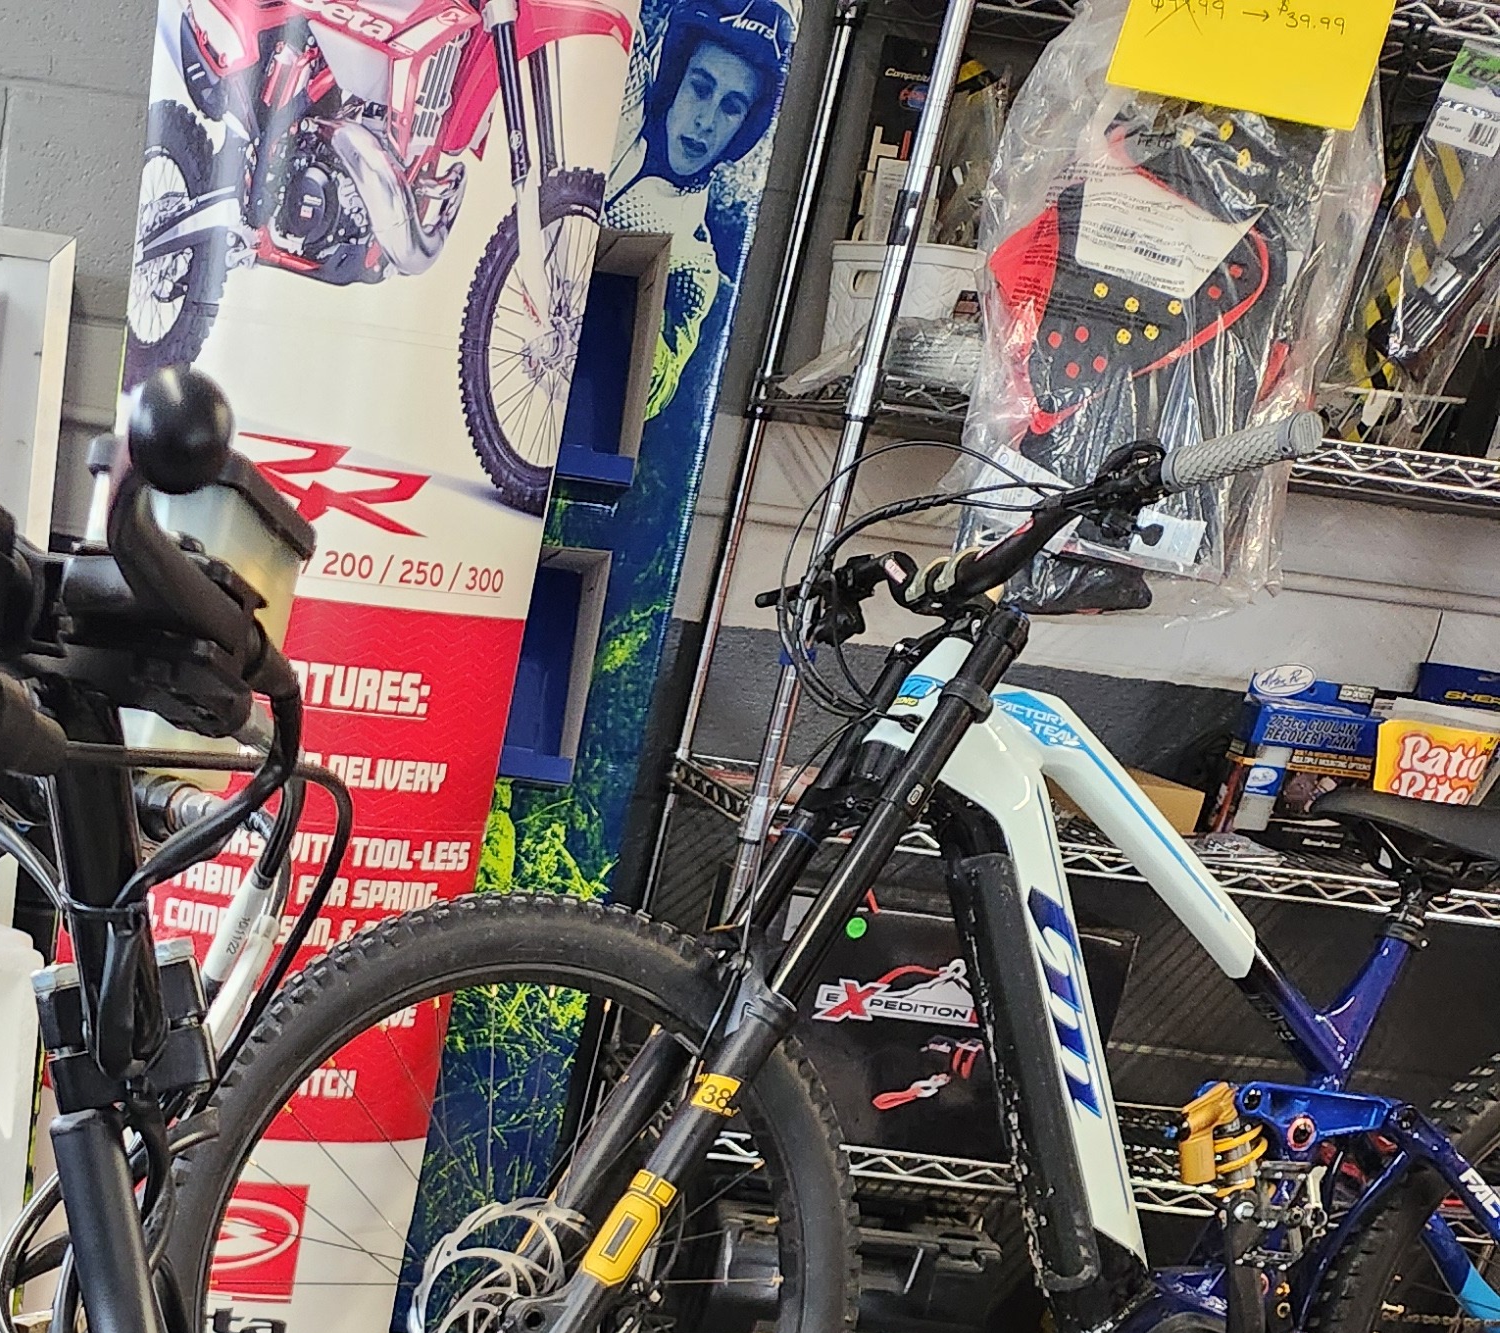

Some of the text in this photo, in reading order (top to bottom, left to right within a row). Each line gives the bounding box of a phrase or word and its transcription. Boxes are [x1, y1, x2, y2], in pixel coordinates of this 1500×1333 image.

[322, 549, 373, 580] 200
[398, 559, 444, 587] 250
[464, 566, 505, 594] 300
[994, 700, 1069, 727] FACTORY
[1306, 719, 1364, 736] COOLANT
[1263, 726, 1362, 751] RECOVERY TANK
[1399, 735, 1489, 781] Ratio
[351, 837, 471, 871] TOOL-LESS
[296, 875, 349, 908] FR
[701, 1084, 731, 1110] 38
